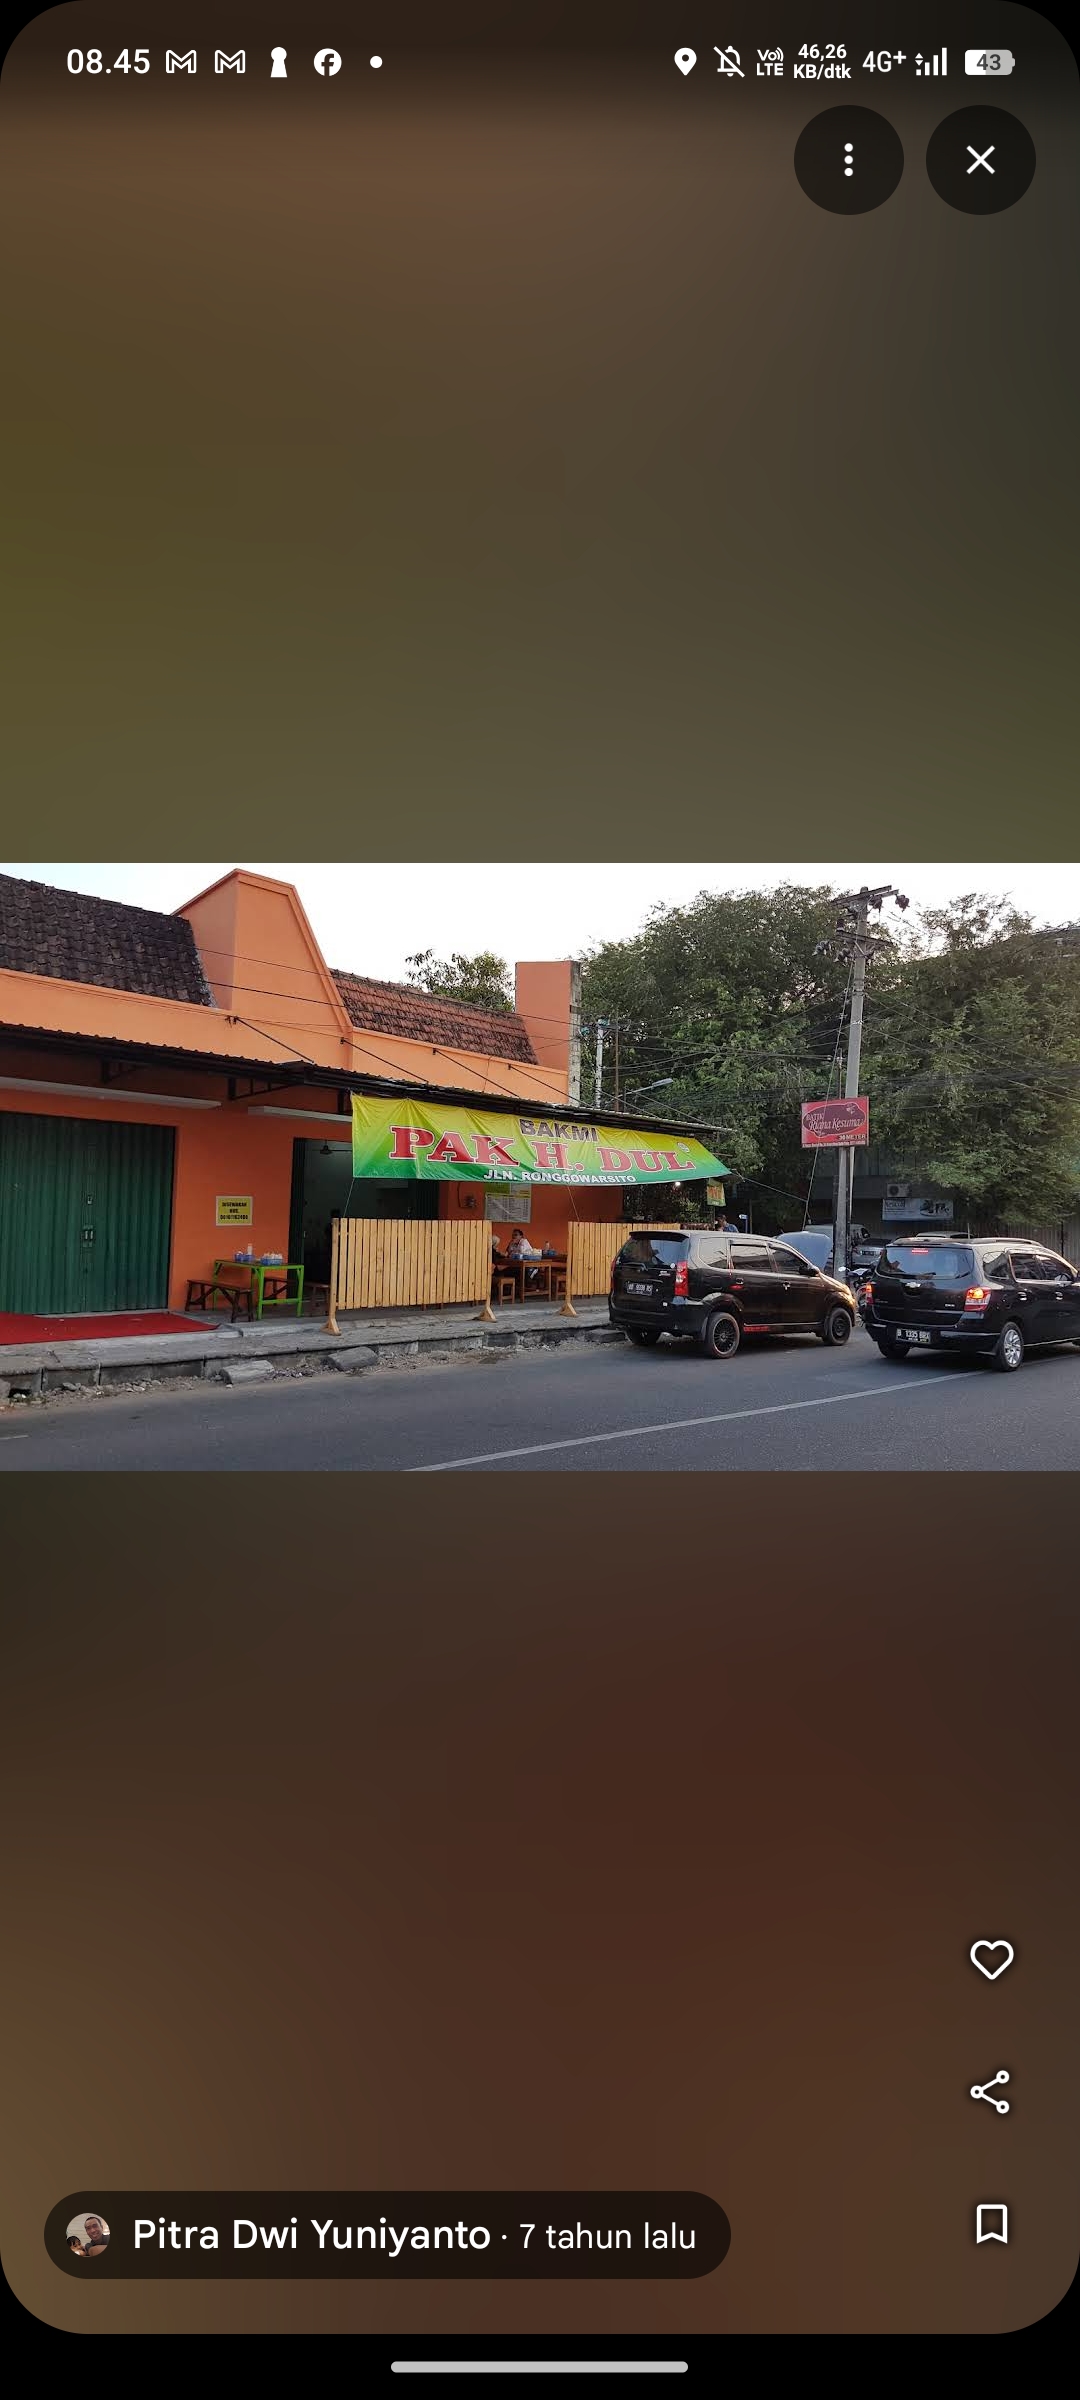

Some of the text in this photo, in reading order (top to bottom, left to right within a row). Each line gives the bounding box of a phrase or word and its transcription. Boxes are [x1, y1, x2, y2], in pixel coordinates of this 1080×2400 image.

[519, 1118, 599, 1142] BAKMI
[390, 1126, 696, 1174] PAK H. DUL
[484, 1169, 636, 1184] JLN. RONGGOWARSITO
